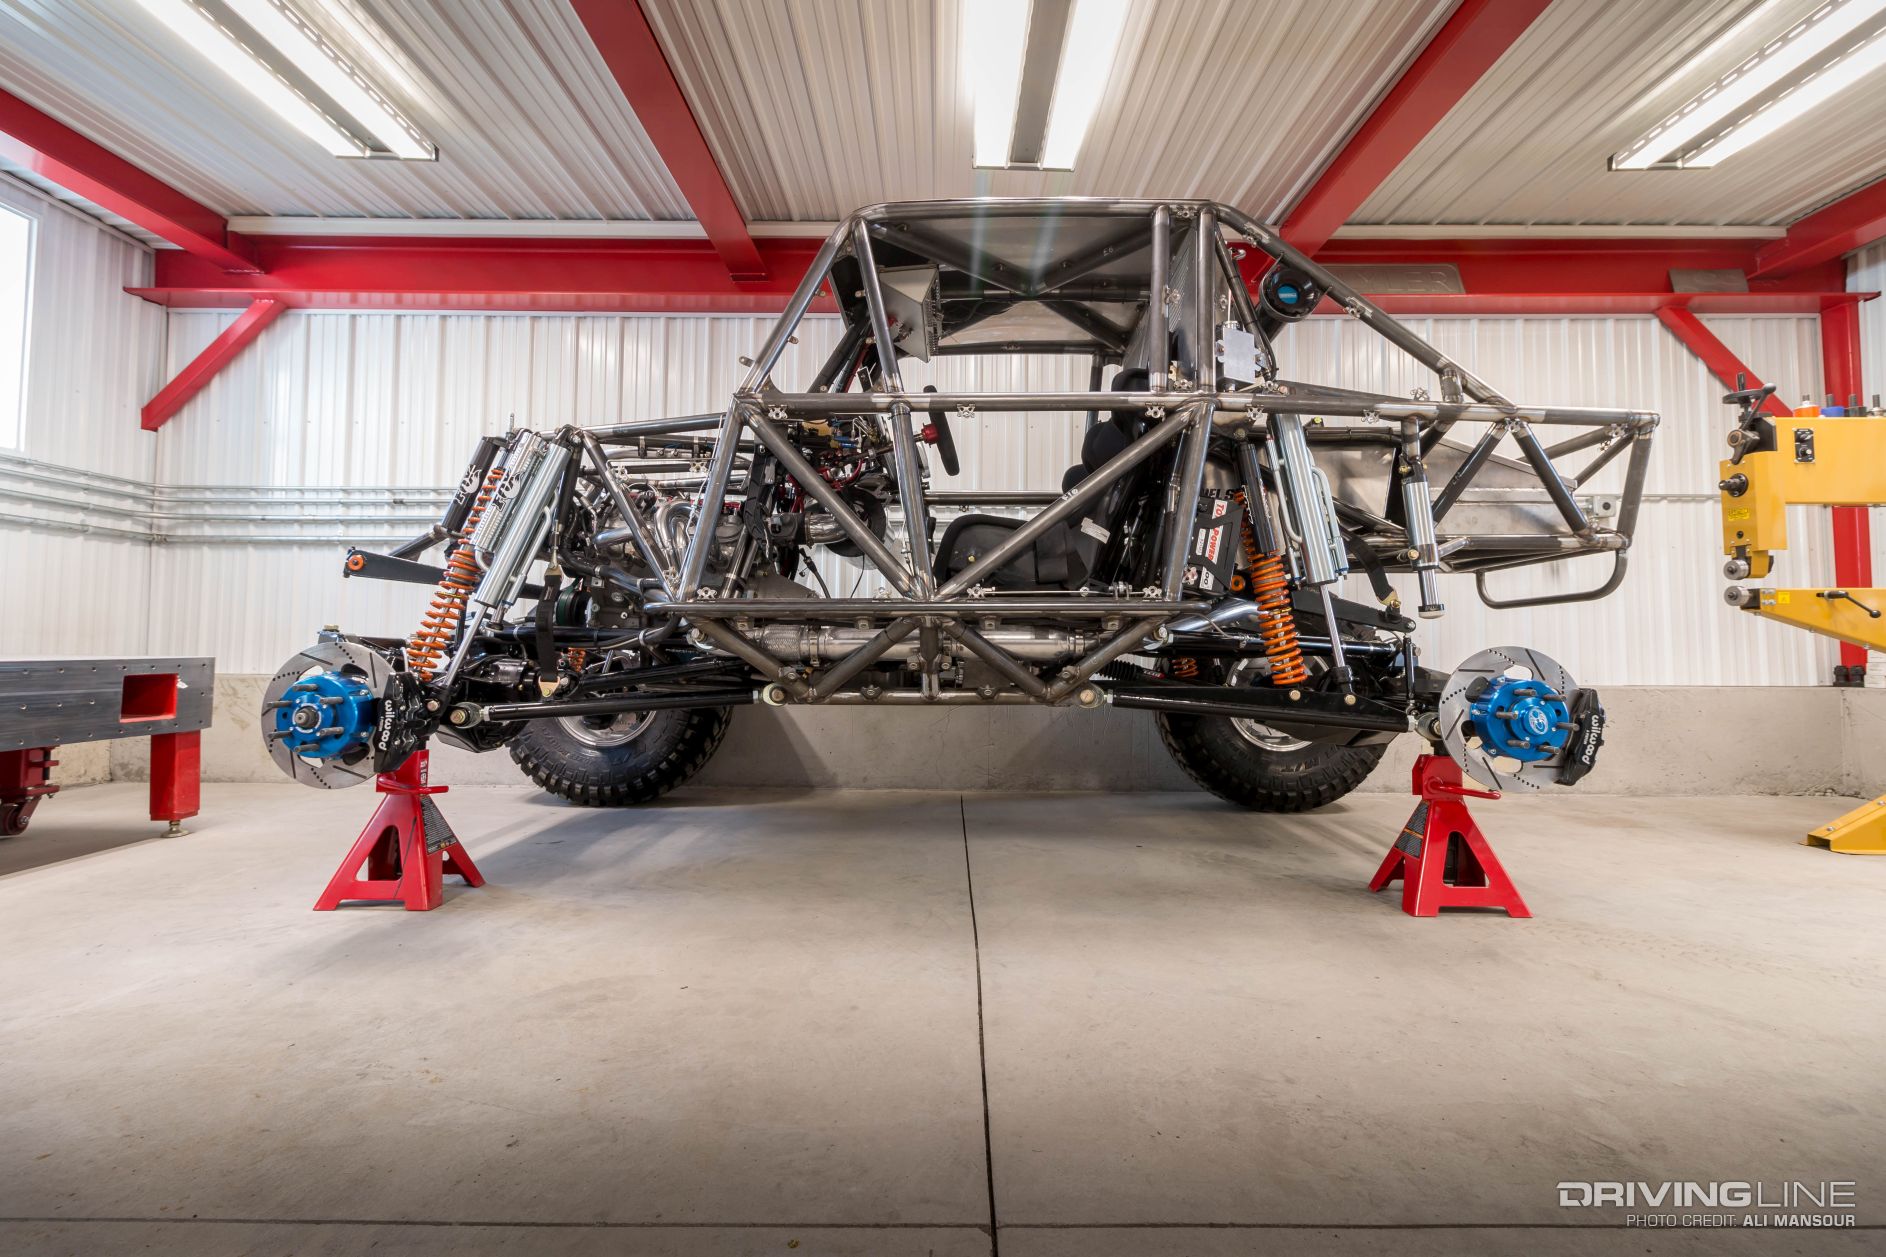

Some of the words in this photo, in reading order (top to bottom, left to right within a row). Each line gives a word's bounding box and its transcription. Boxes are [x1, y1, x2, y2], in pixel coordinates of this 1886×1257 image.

[1207, 527, 1220, 561] POWER
[378, 699, 396, 751] wilwood
[1581, 714, 1602, 765] wilwood
